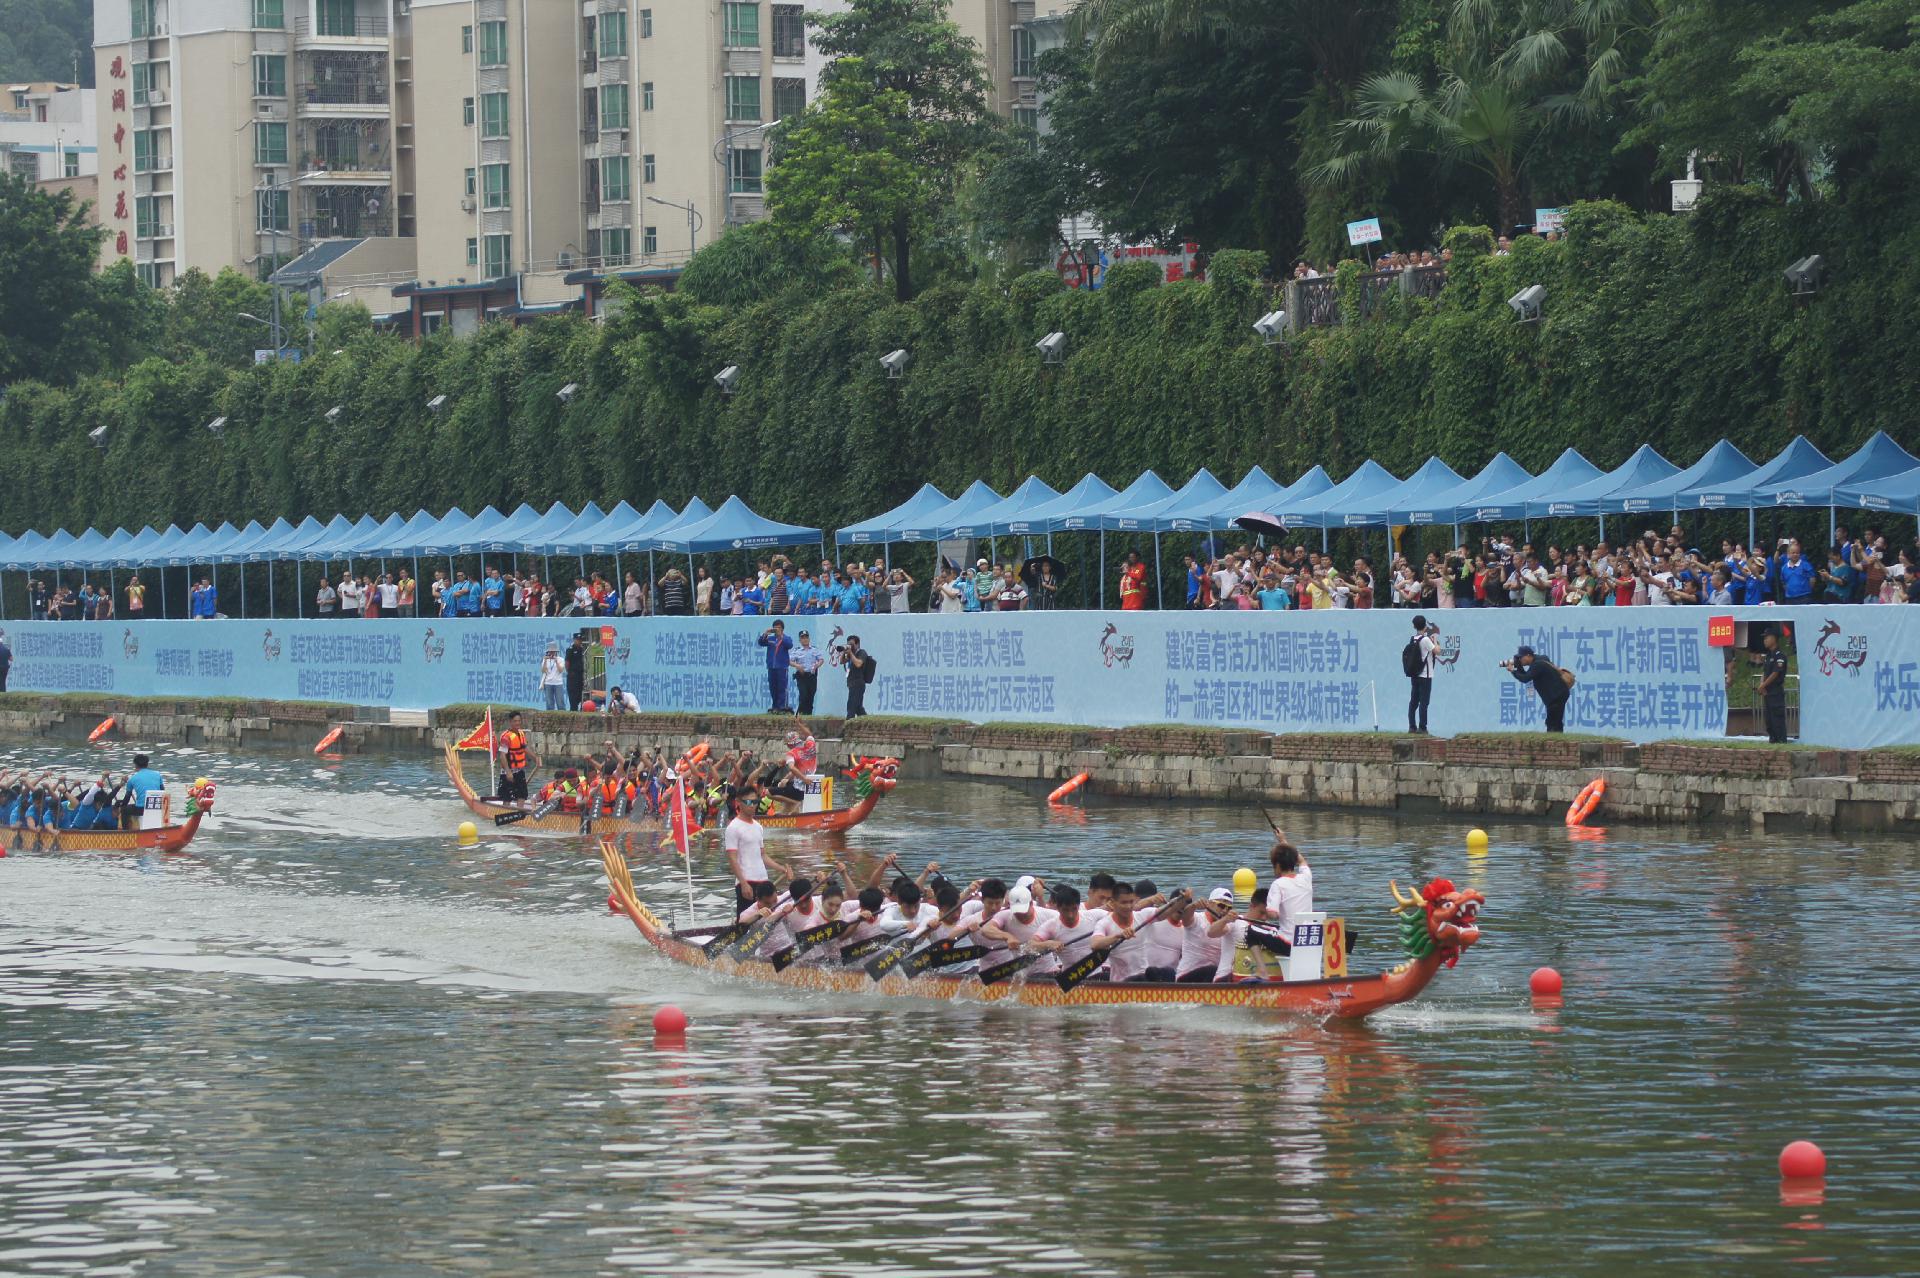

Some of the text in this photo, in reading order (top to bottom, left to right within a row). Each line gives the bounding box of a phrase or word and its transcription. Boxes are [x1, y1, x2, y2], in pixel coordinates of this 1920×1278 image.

[290, 632, 402, 665] 坚定不移走改革开放的强国之路
[902, 630, 1026, 669] 建设好粤港澳大湾区
[1165, 629, 1359, 674] 建设富有活力和国际竞争力
[1847, 635, 1868, 650] 2019
[298, 667, 394, 700] 做到改革不停顿开放不止步
[877, 674, 1056, 714] 打造质量发展的先行区示范区
[1164, 678, 1359, 725] 的一流湾区和世界级城市群
[1874, 660, 1920, 713] 快乐
[1328, 920, 1342, 969] 3
